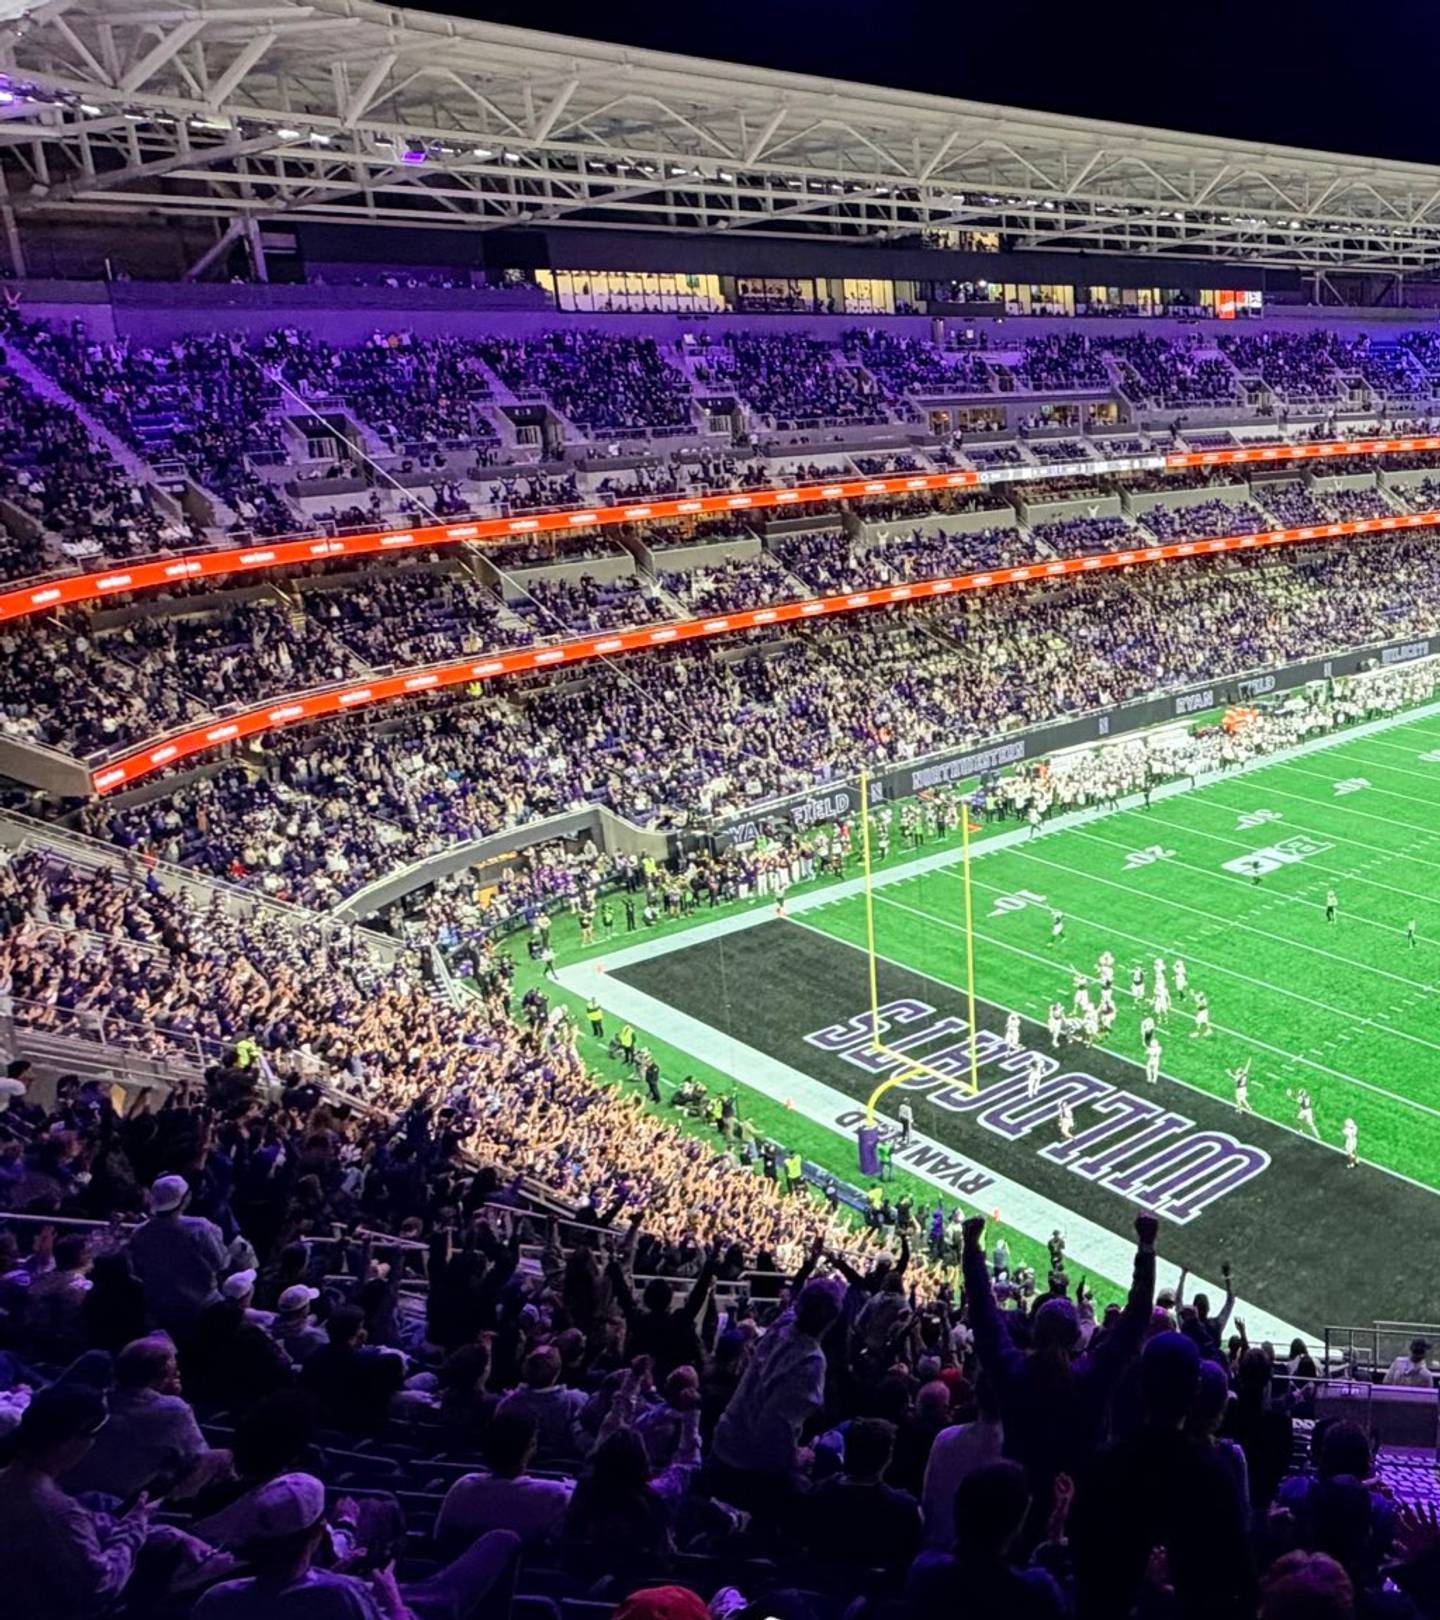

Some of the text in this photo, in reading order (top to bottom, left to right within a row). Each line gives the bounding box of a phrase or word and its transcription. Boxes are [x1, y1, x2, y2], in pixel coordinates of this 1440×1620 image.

[911, 740, 1025, 791] NORTHWESTERN
[790, 793, 850, 828] FIELD
[993, 889, 1047, 911] 10
[802, 998, 1273, 1226] WILDCATS
[901, 1145, 997, 1195] RYAN
